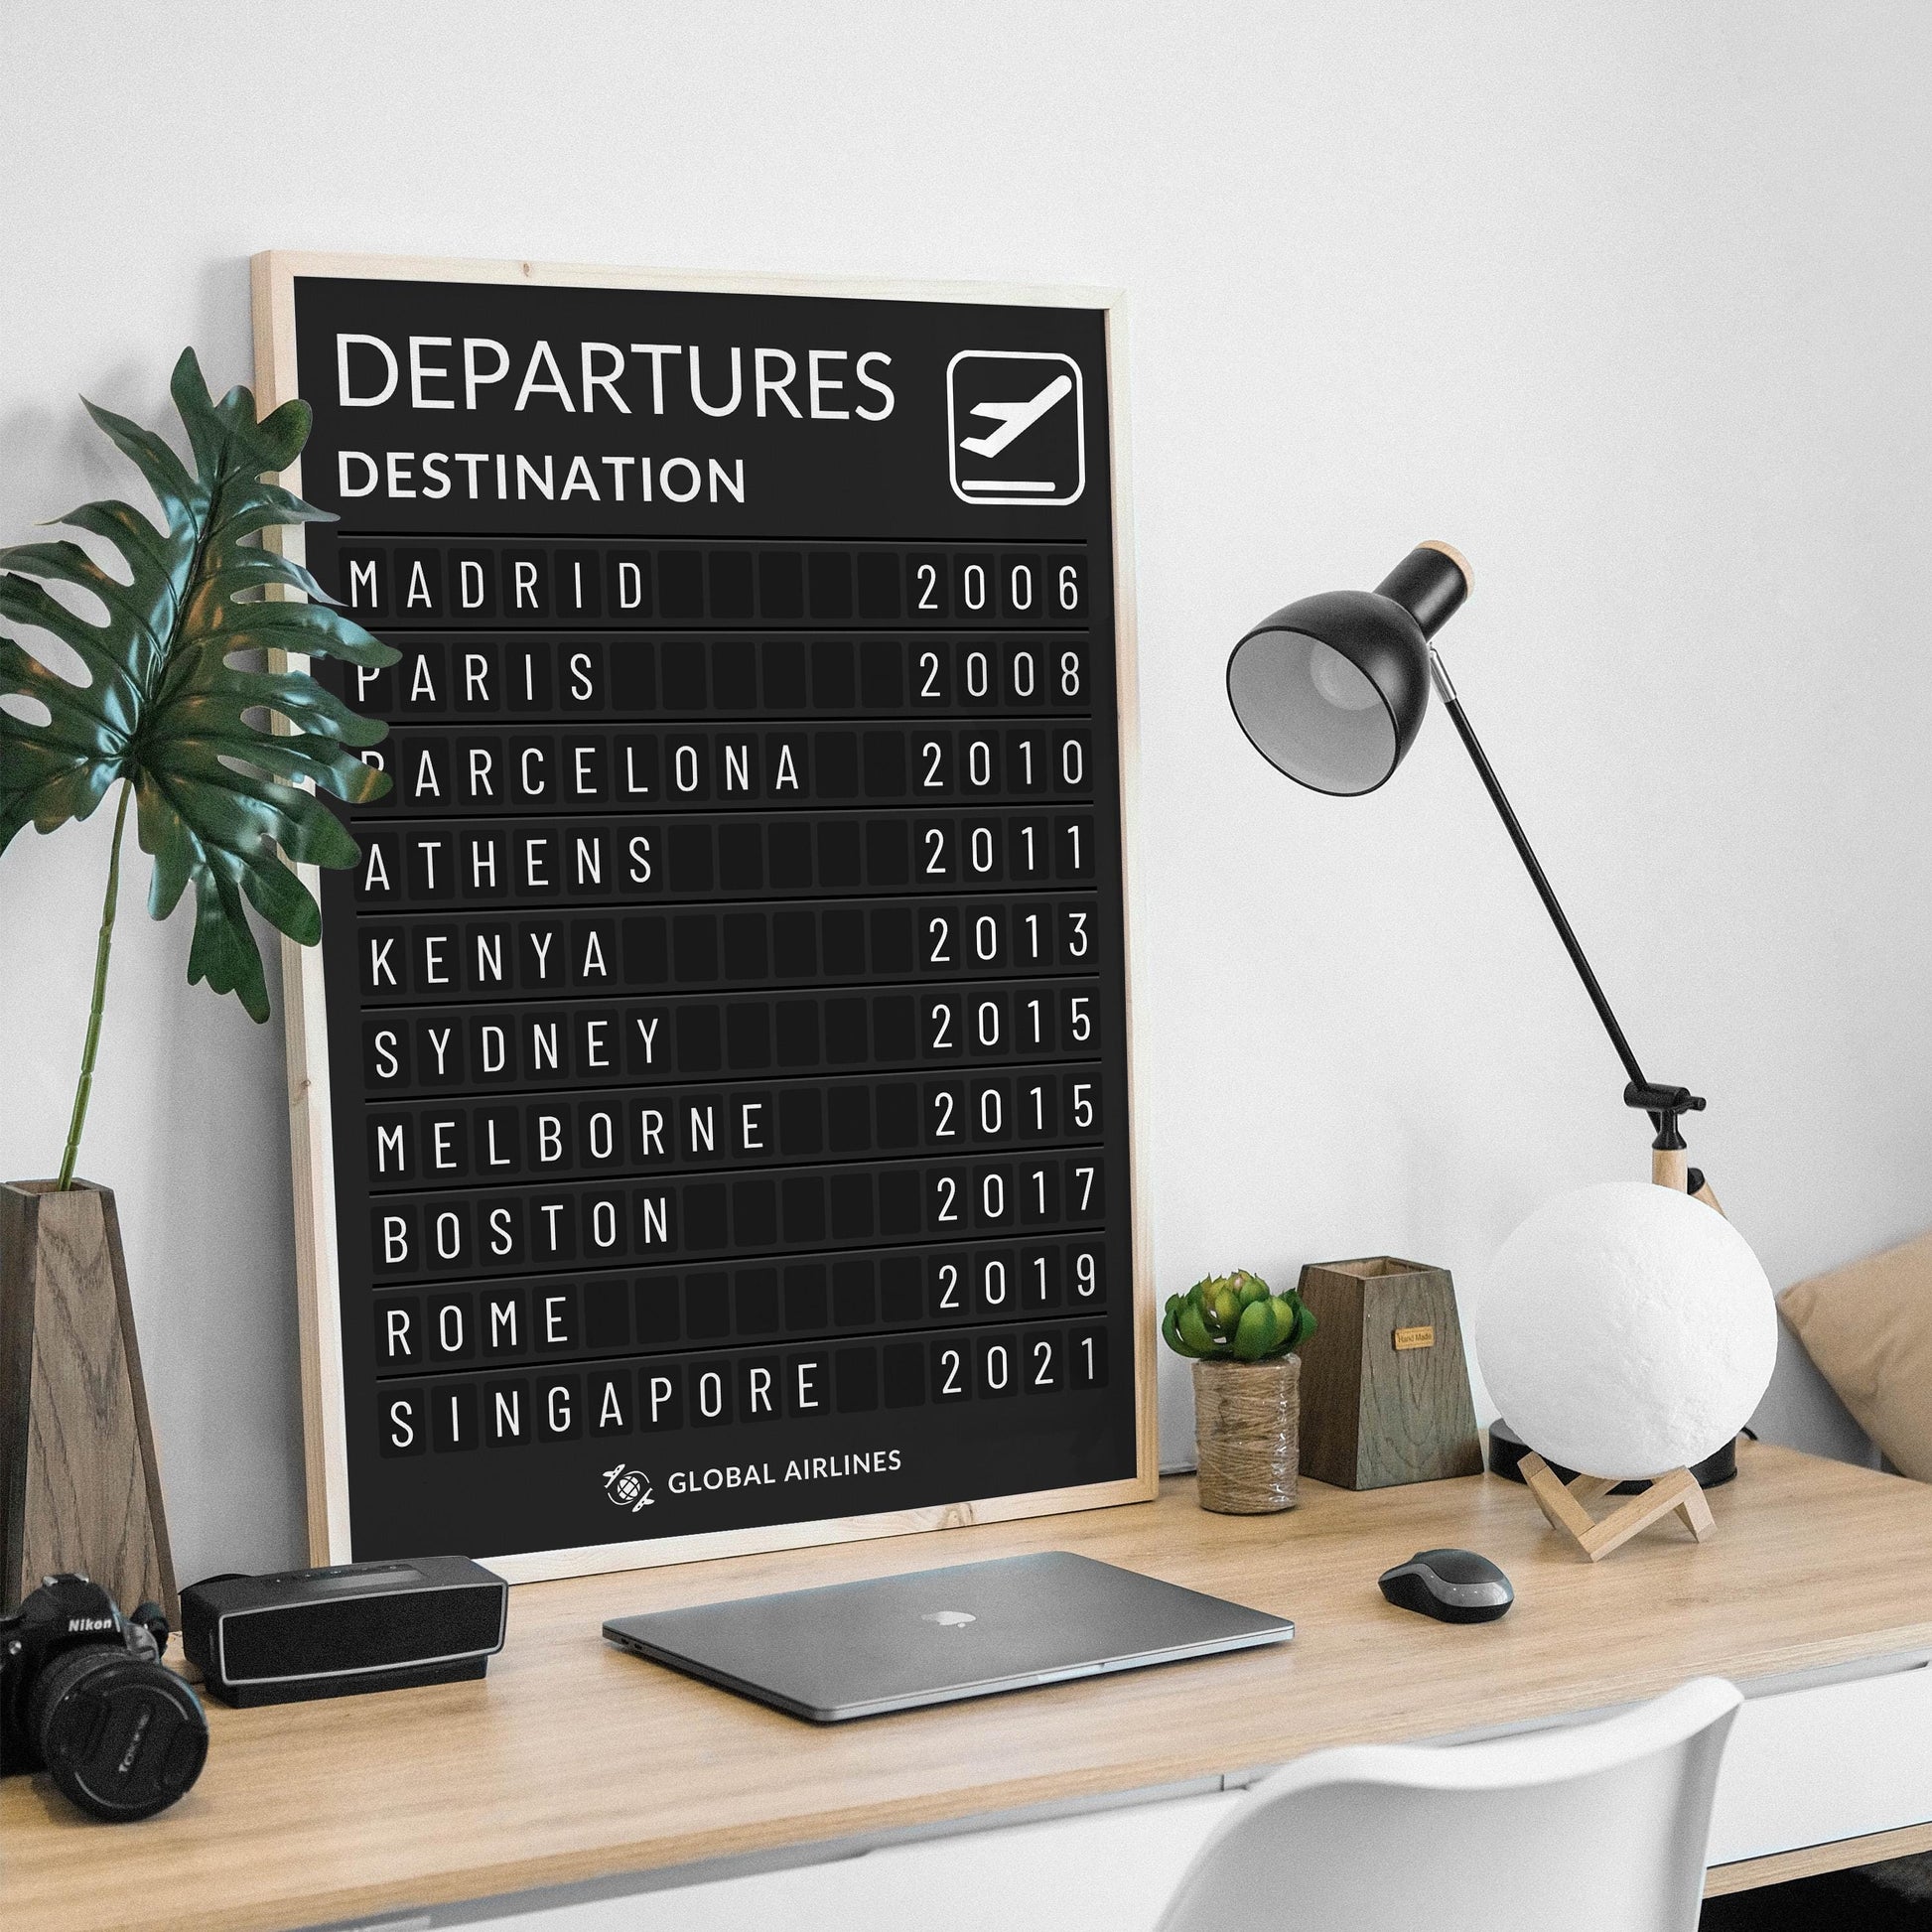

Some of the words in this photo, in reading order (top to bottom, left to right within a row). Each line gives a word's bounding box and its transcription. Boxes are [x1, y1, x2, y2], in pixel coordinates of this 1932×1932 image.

[337, 334, 895, 421] DEPARTURES
[339, 451, 745, 502] DESTINATION
[350, 561, 640, 608] MADRID
[917, 565, 1077, 610] 2006
[357, 653, 592, 701] PARIS
[920, 652, 1079, 697] 2008
[923, 740, 1082, 786] 2010
[365, 837, 650, 891] ATHENS
[925, 826, 1079, 873] 2011
[371, 931, 607, 985] KENYA
[930, 913, 1087, 961] 2013
[375, 1019, 658, 1077] SYDNEY
[932, 998, 1090, 1047] 2015
[378, 1104, 762, 1172] MELBORNE
[935, 1084, 1092, 1136] 2015
[384, 1197, 666, 1263] BOSTON
[937, 1168, 1093, 1221] 2017
[387, 1297, 567, 1356] ROME
[939, 1254, 1095, 1308] 2019
[391, 1363, 818, 1447] SINGAPORE
[942, 1338, 1093, 1393] 2021
[668, 1463, 775, 1493] GLOBAL
[784, 1449, 900, 1481] AIRLINES
[69, 1618, 112, 1631] Nikon
